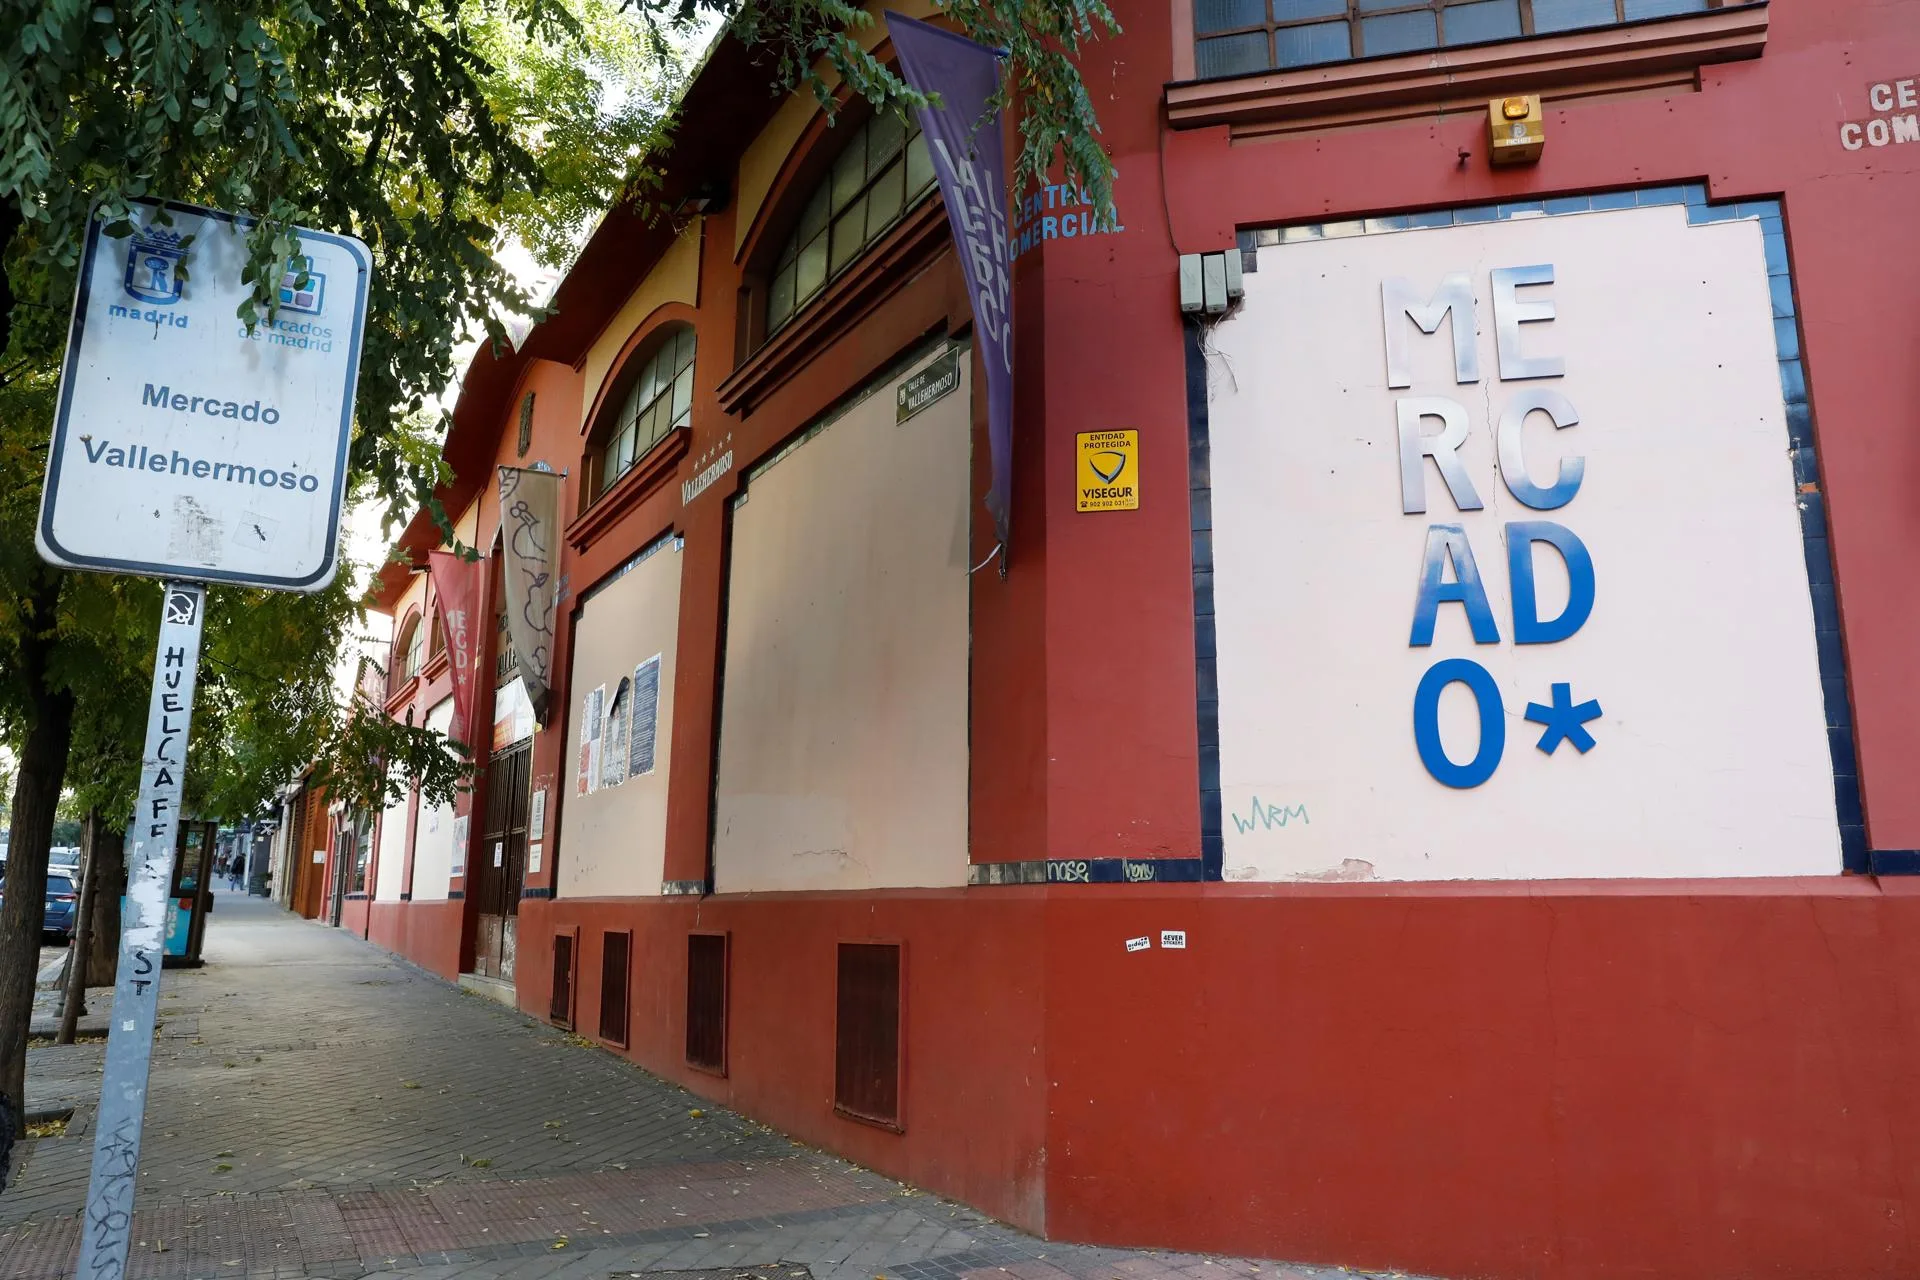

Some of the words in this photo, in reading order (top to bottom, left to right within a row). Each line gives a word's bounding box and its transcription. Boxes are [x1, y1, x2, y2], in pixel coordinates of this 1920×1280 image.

[1010, 211, 1125, 264] OMERCIAL
[108, 303, 189, 329] madrid
[255, 317, 333, 338] ercados
[268, 332, 332, 353] madrid
[908, 372, 953, 412] VALLEHERMOSO
[142, 383, 280, 425] Mercado
[1084, 440, 1131, 449] PROTEGIDA
[1090, 432, 1125, 441] ENTIDAD
[83, 438, 319, 493] Vallehermoso
[1083, 486, 1133, 499] VISEGUR
